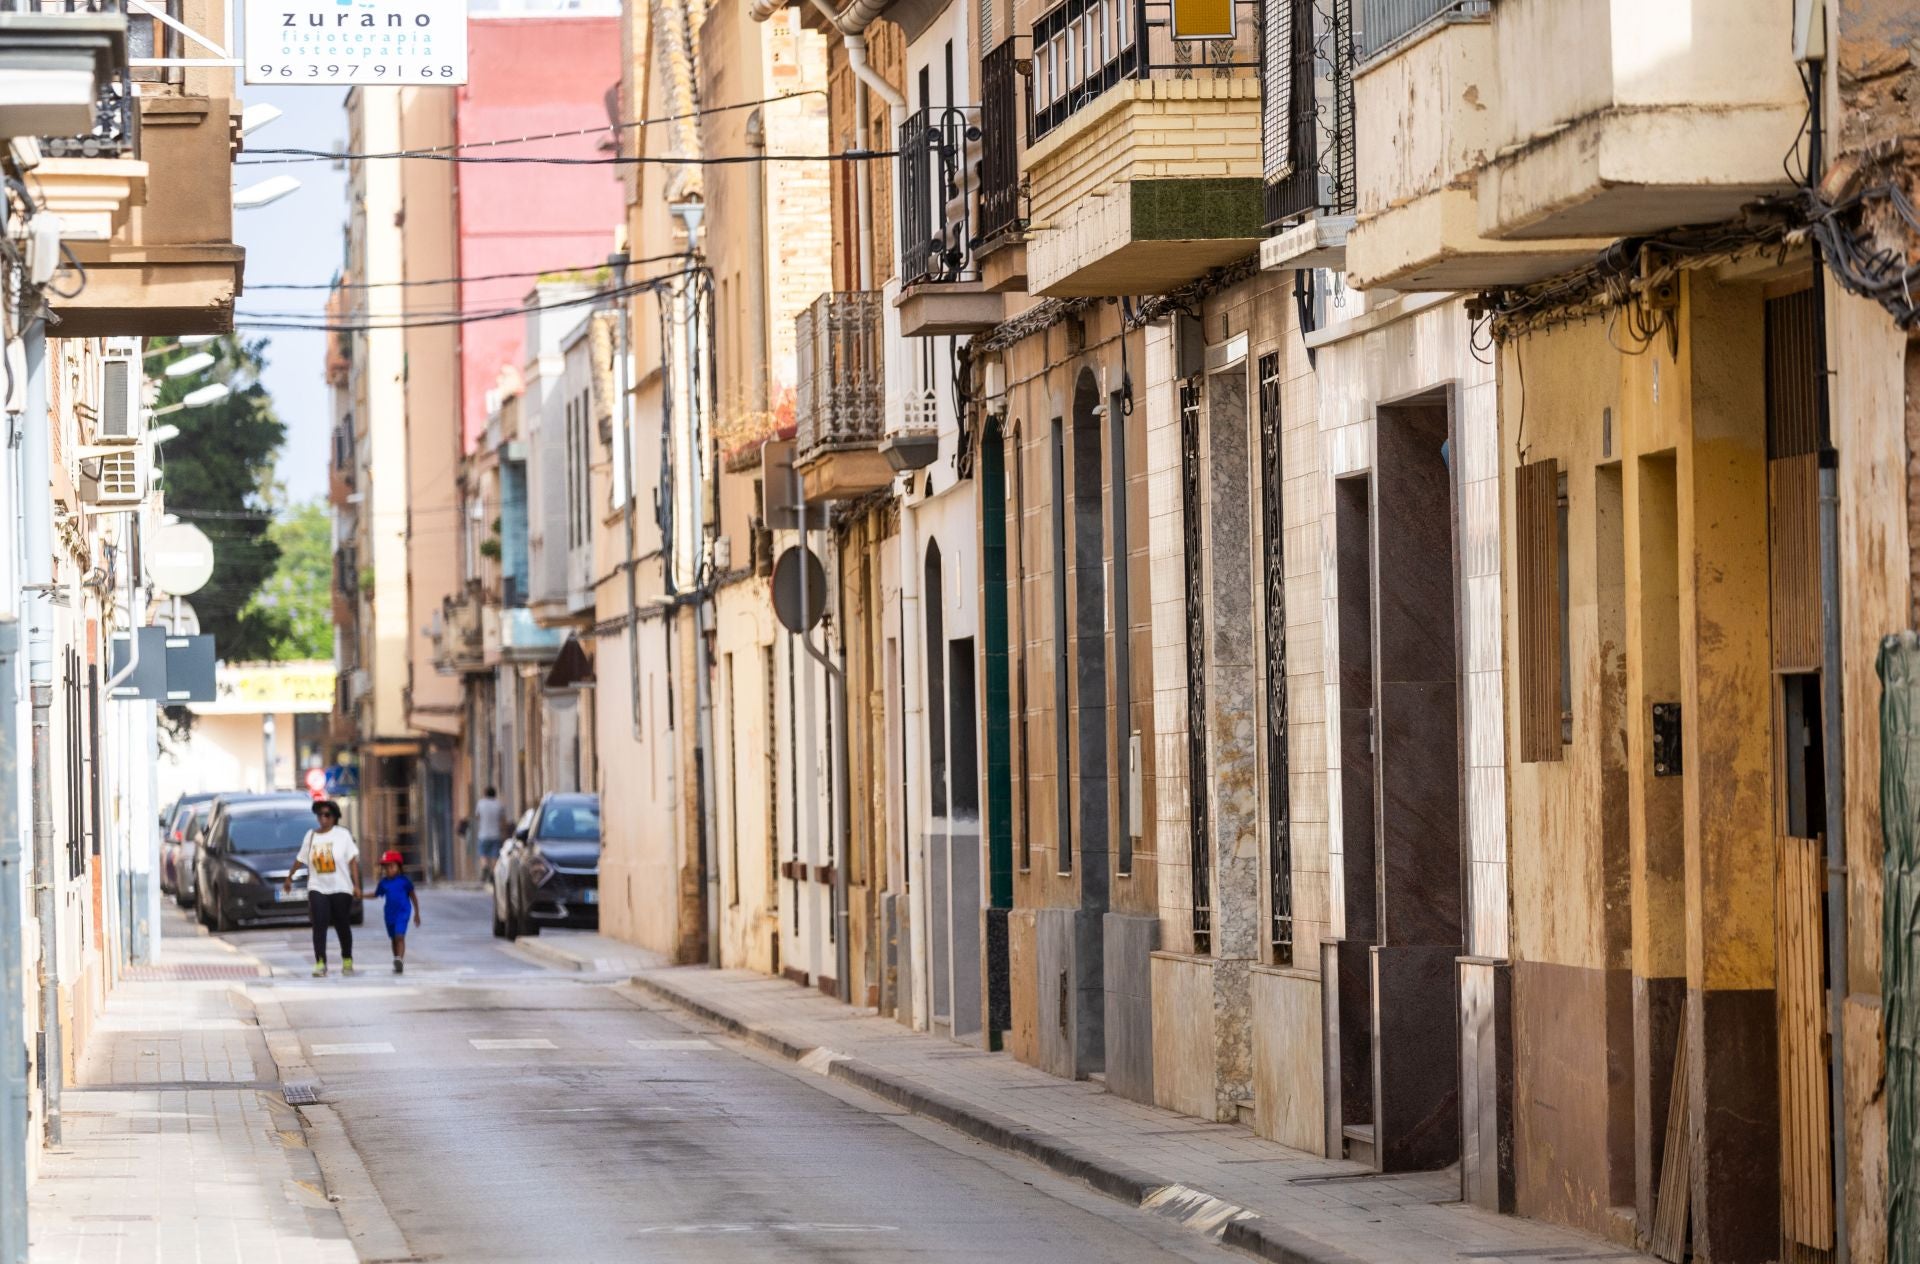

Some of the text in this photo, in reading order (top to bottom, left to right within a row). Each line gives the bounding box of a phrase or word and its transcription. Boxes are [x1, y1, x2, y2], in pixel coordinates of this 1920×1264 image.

[282, 13, 431, 27] zurano
[282, 31, 432, 45] fisioterapia
[282, 46, 432, 58] osteopatia
[260, 64, 454, 78] 96 397 91 68
